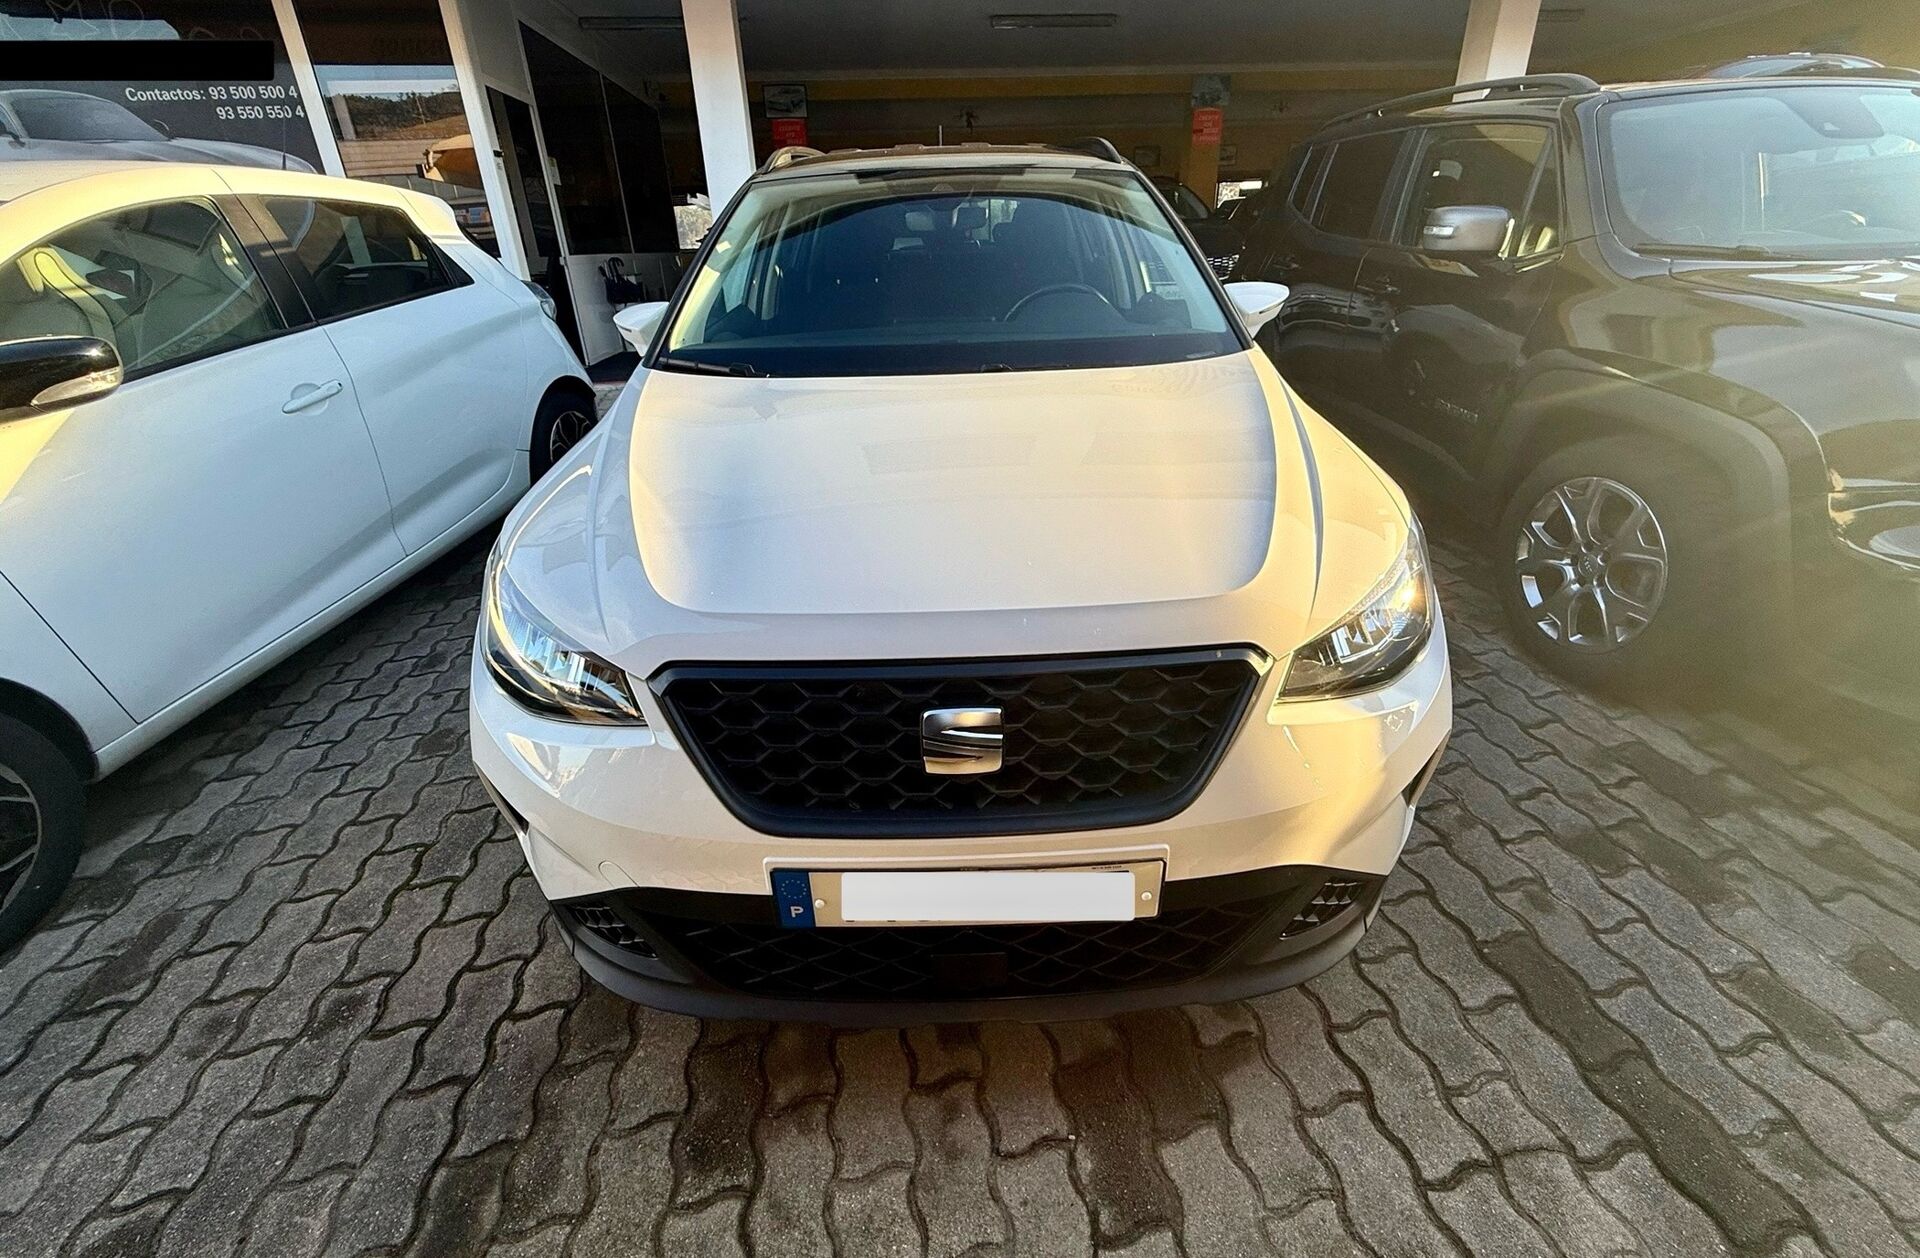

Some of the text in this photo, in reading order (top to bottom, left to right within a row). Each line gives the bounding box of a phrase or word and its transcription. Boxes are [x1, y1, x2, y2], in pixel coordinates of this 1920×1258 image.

[125, 85, 298, 101] Contactos: 93 500 500 4
[216, 105, 305, 120] 93 550 550 4
[790, 906, 804, 918] P
